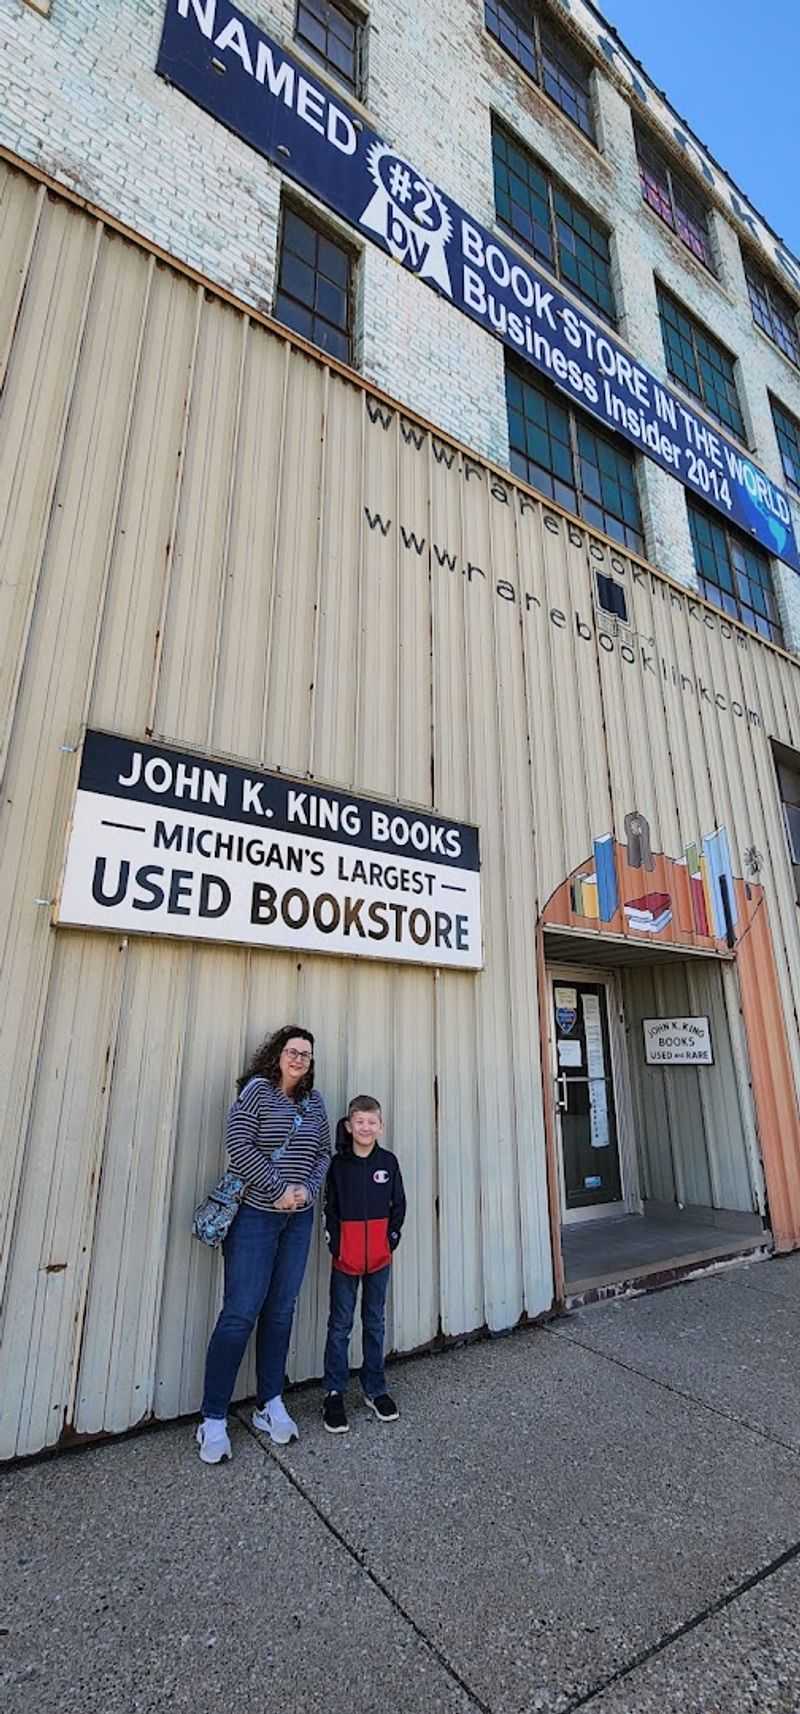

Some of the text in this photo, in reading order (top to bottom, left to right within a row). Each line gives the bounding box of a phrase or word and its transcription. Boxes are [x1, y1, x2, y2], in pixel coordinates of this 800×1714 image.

[177, 0, 357, 155] NAMED
[388, 163, 434, 227] #2
[387, 202, 429, 273] by
[461, 219, 791, 525] BOOK STORE IN THE WORLD
[463, 268, 733, 511] Business Insider 2014
[118, 752, 462, 858] JOHN K. KING BOOKS
[153, 820, 436, 896] MICHIGAN'S LARGEST
[91, 856, 470, 951] USED BOOKSTORE
[648, 1023, 670, 1039] JOHN
[682, 1022, 705, 1038] KING
[651, 1051, 673, 1060] USED
[686, 1051, 709, 1060] RARE
[658, 1036, 695, 1047] BOOKS
